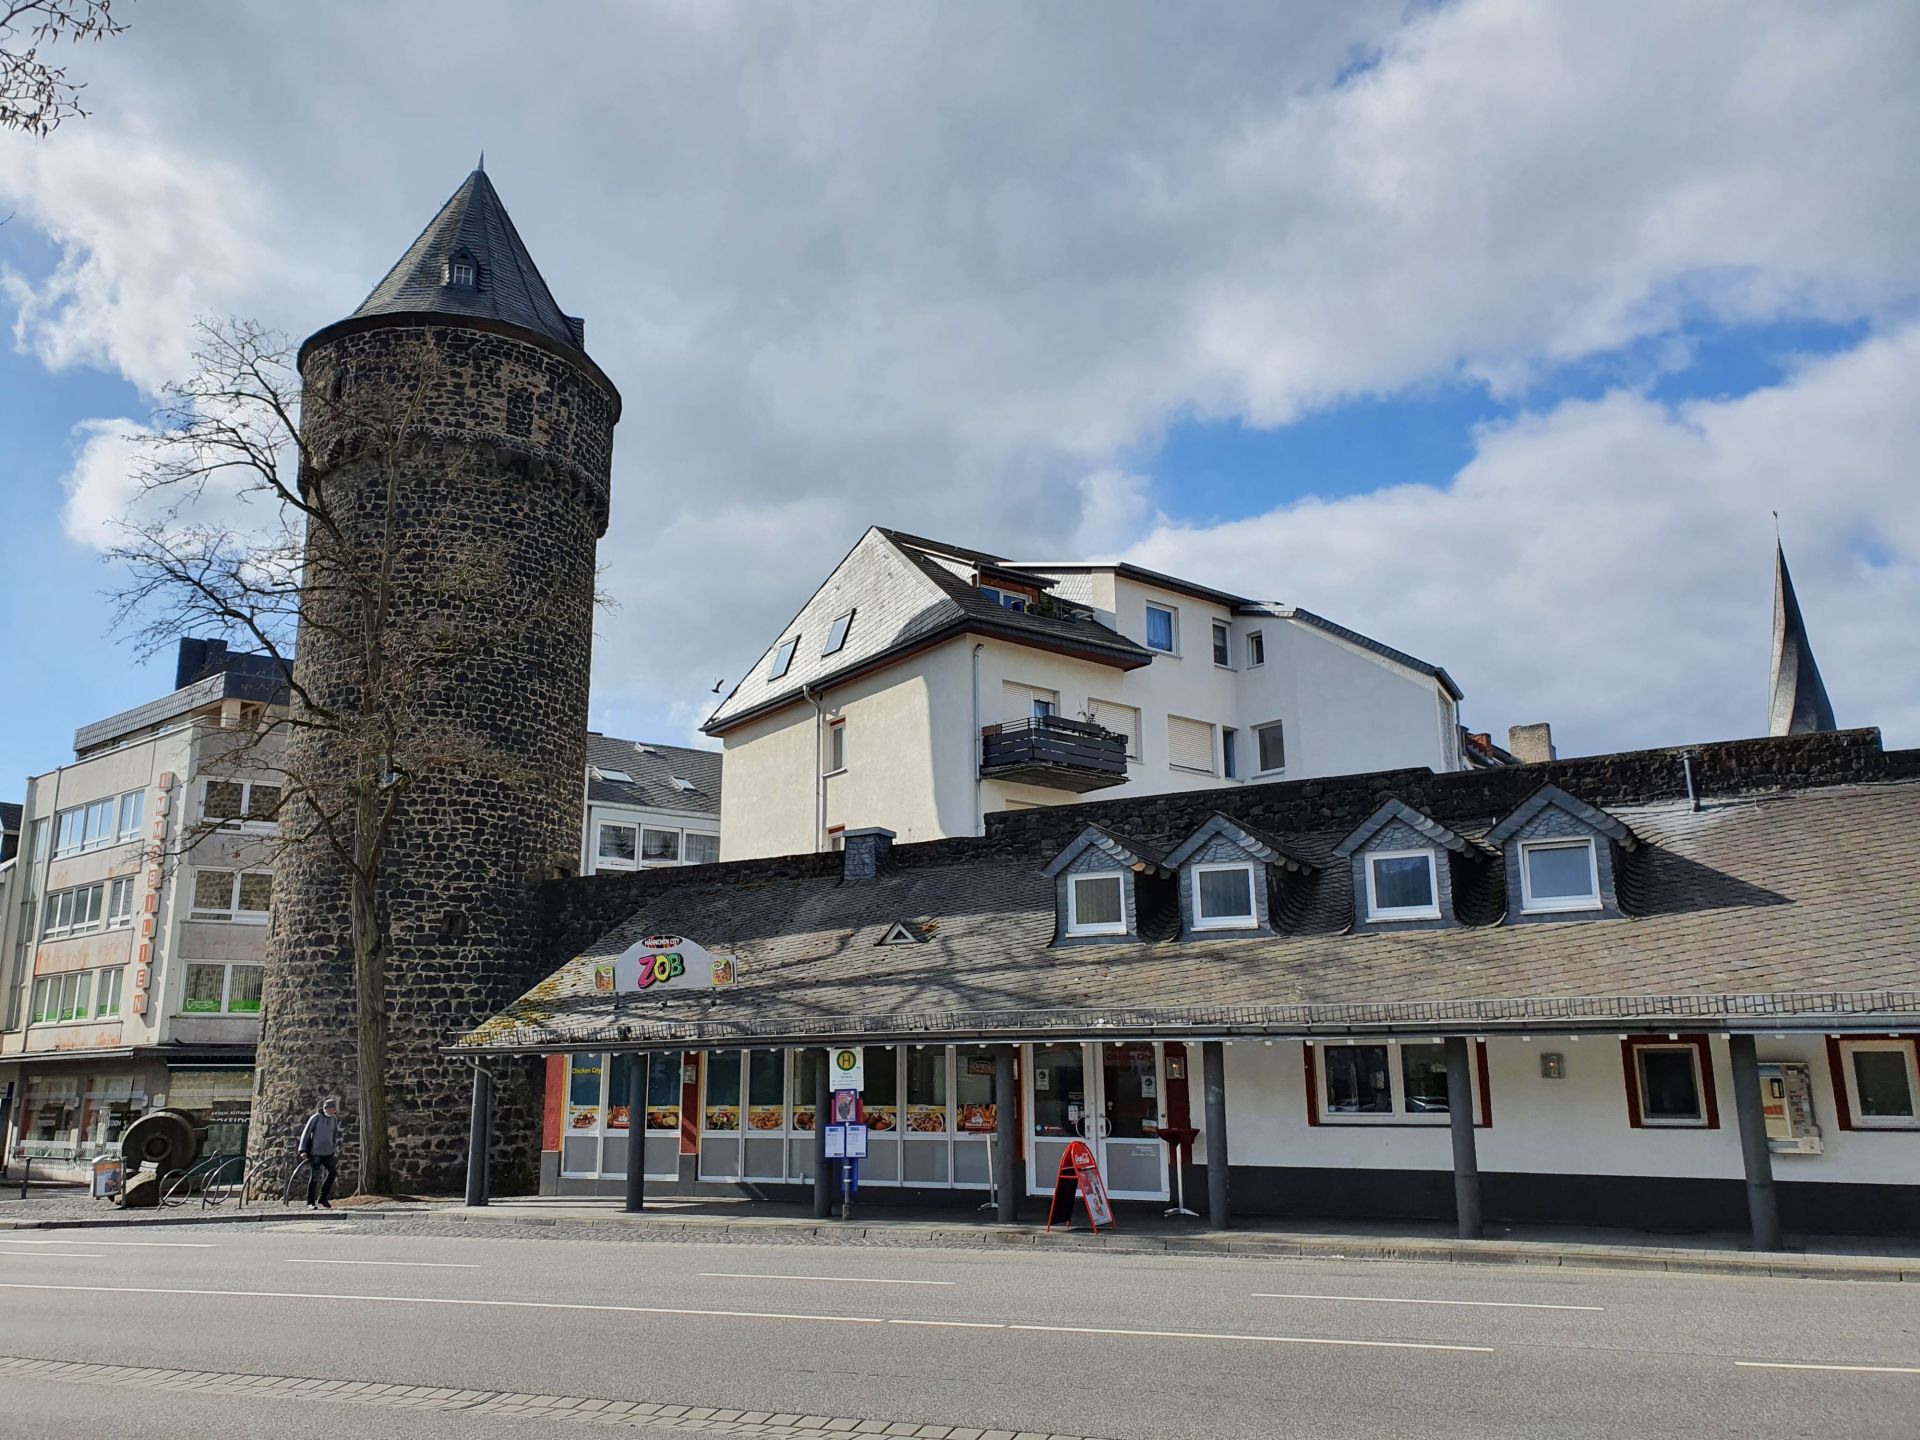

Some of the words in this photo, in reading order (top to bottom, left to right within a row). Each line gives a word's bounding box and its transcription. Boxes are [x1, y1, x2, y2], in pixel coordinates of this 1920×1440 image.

[133, 773, 170, 1014] IMMOBILIEN
[638, 953, 685, 989] ZOB
[842, 1055, 850, 1066] H
